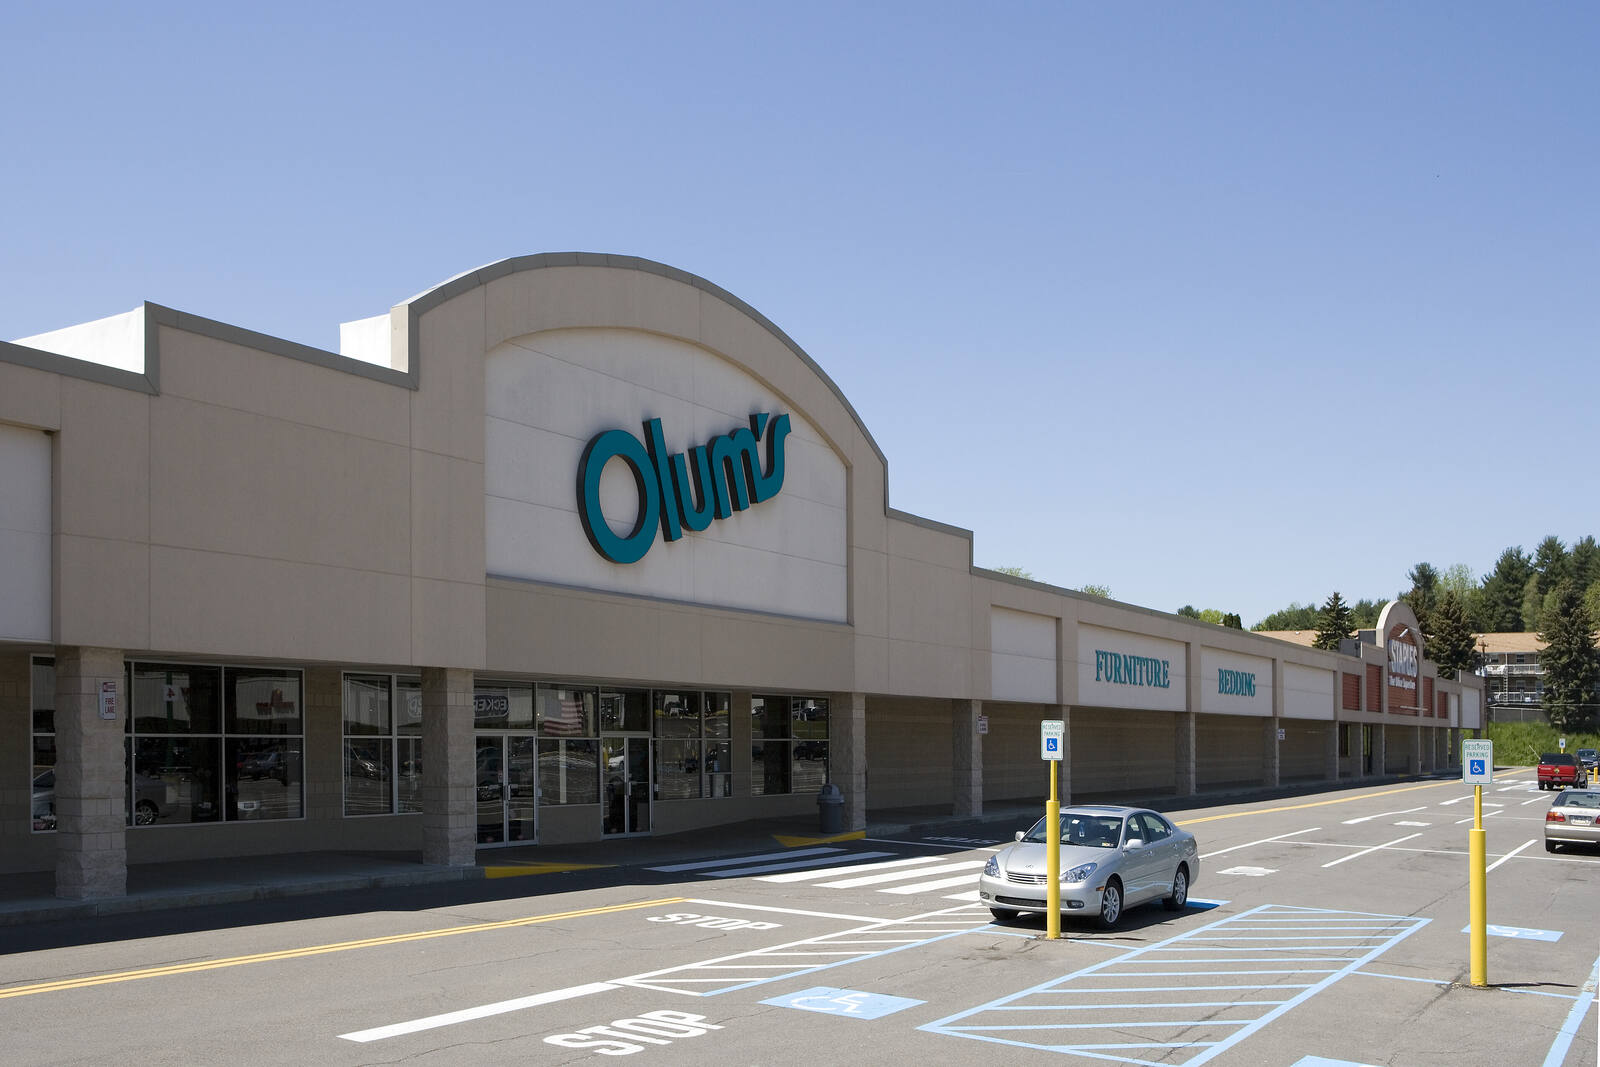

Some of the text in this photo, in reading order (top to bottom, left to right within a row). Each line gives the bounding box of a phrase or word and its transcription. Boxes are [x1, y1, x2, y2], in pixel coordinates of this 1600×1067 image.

[576, 413, 791, 564] Olum's
[1095, 649, 1170, 688] FURNITURE
[1390, 639, 1418, 677] STAPLES
[1218, 668, 1256, 697] BEDDING
[1464, 743, 1490, 751] RESERVED
[646, 913, 783, 931] STOP
[543, 1010, 725, 1056] STOP
